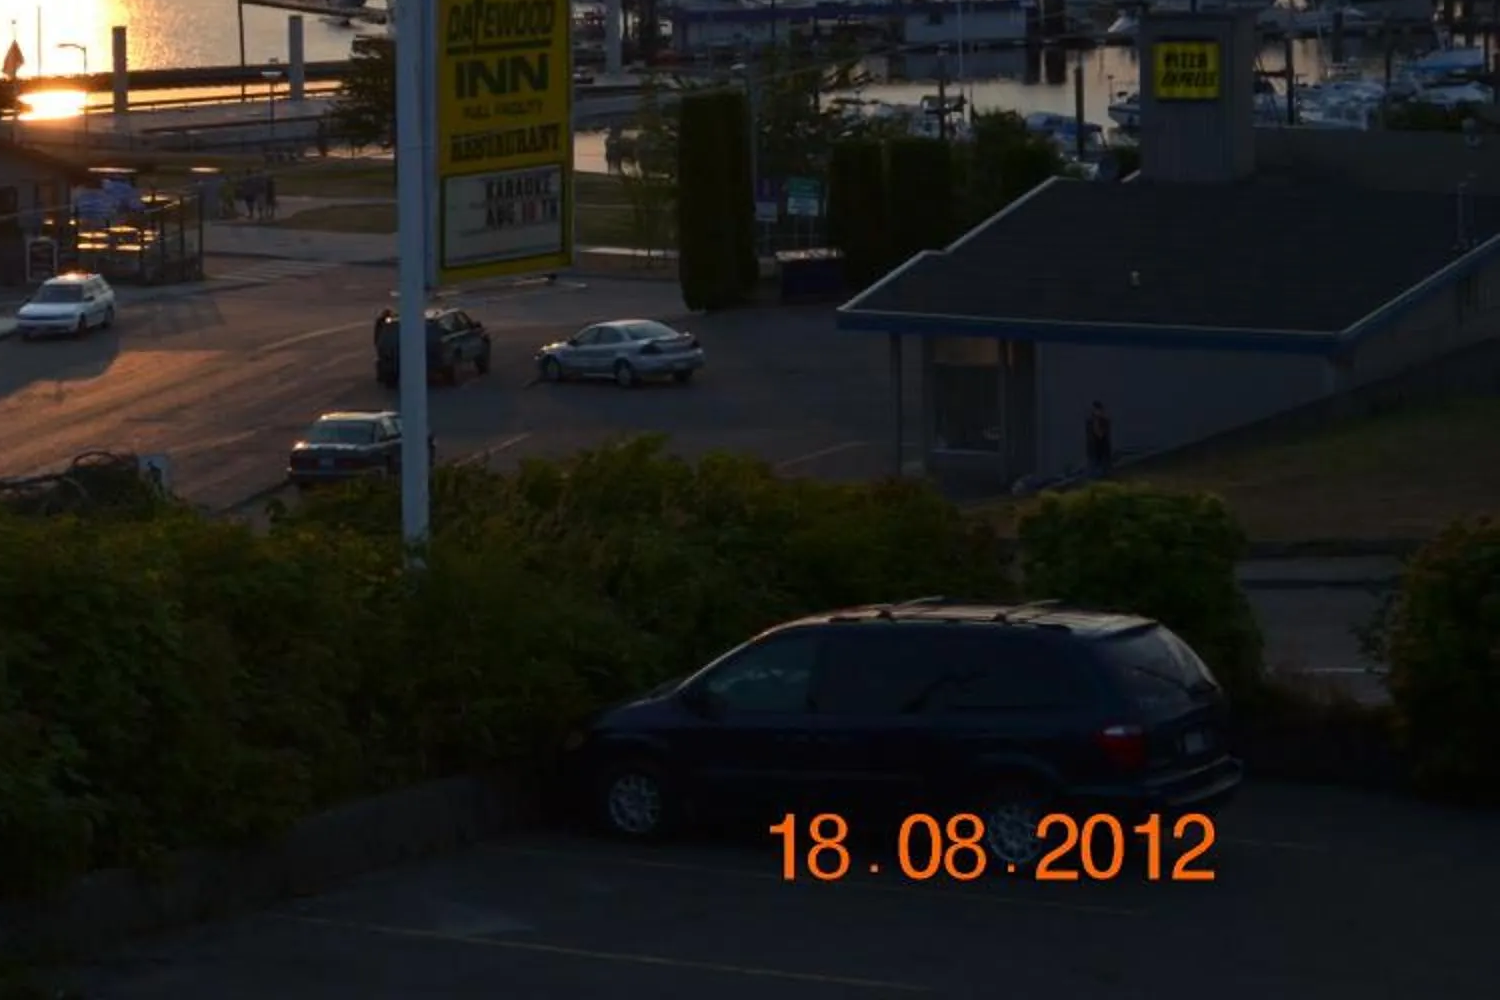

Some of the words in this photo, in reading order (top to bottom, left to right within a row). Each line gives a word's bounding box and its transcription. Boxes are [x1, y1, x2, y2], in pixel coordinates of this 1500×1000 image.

[456, 53, 549, 99] INN
[449, 123, 562, 162] RESTAURANT
[486, 176, 552, 199] KARAOKE
